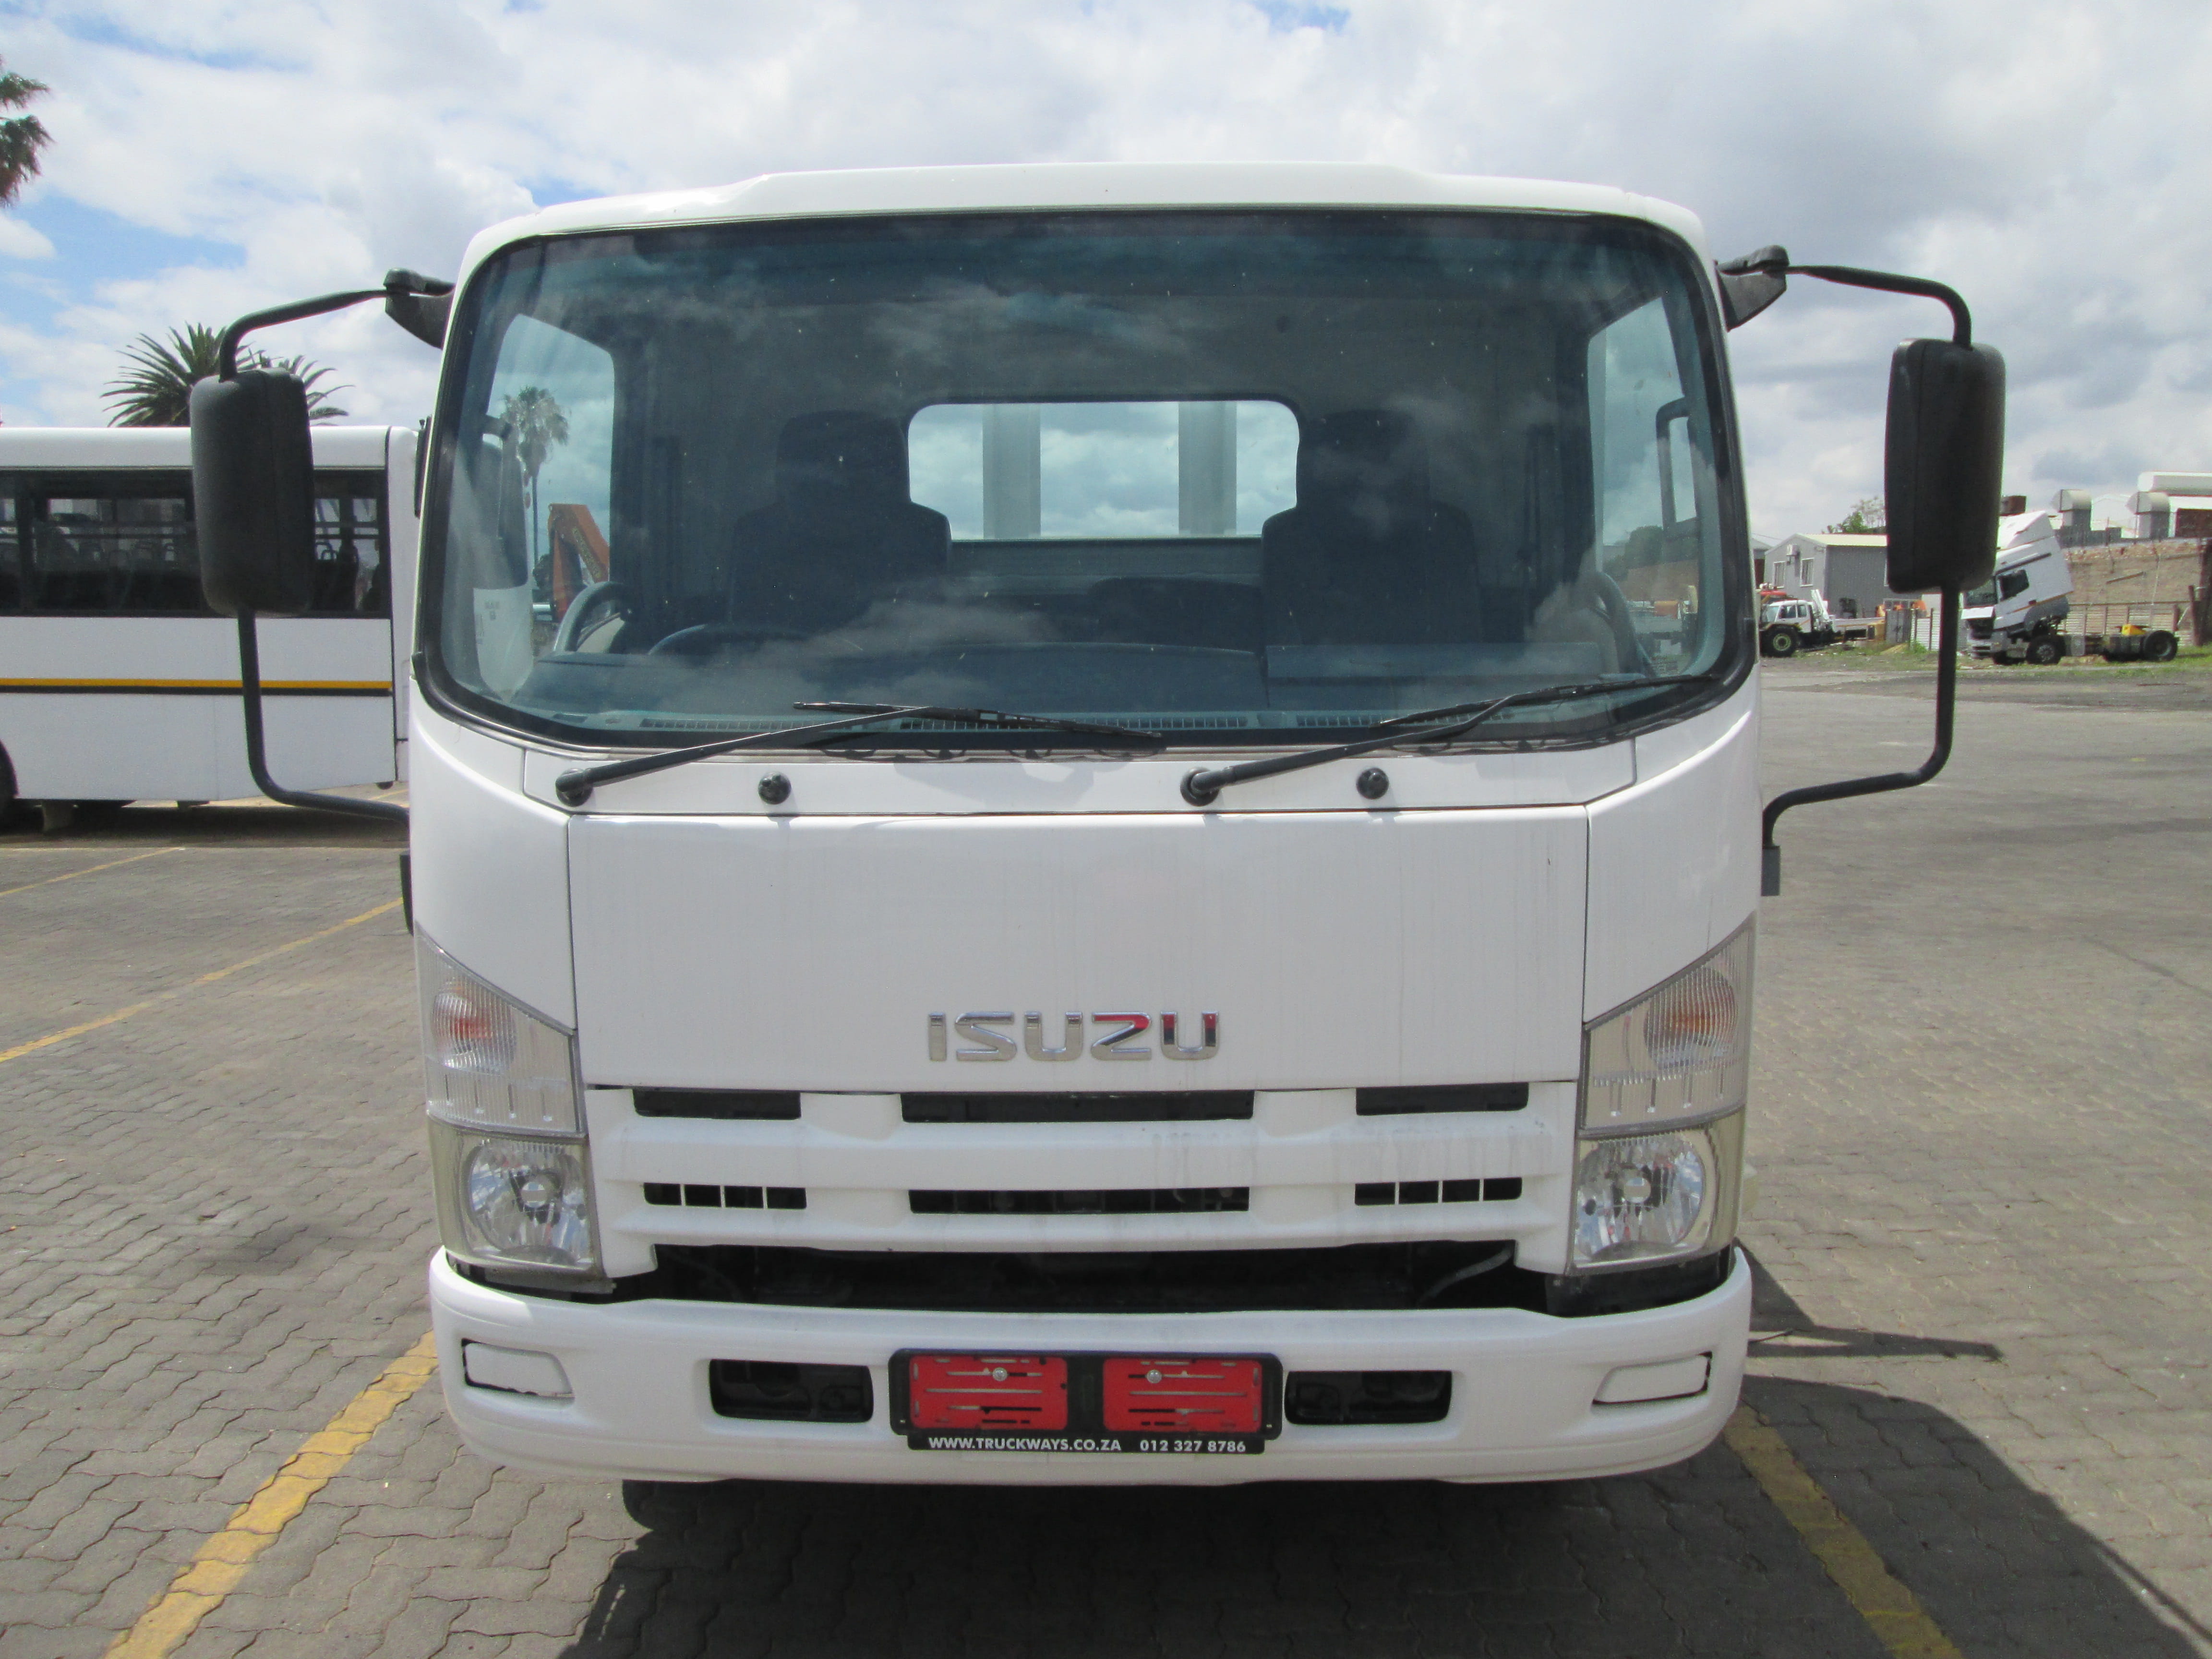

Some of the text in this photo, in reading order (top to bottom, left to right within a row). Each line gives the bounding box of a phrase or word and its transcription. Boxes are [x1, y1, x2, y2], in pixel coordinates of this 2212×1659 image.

[928, 1011, 1219, 1061] ISUZU
[928, 1437, 1246, 1453] WWW.TRUCKWAYS.CO.ZA 012 327 8786
